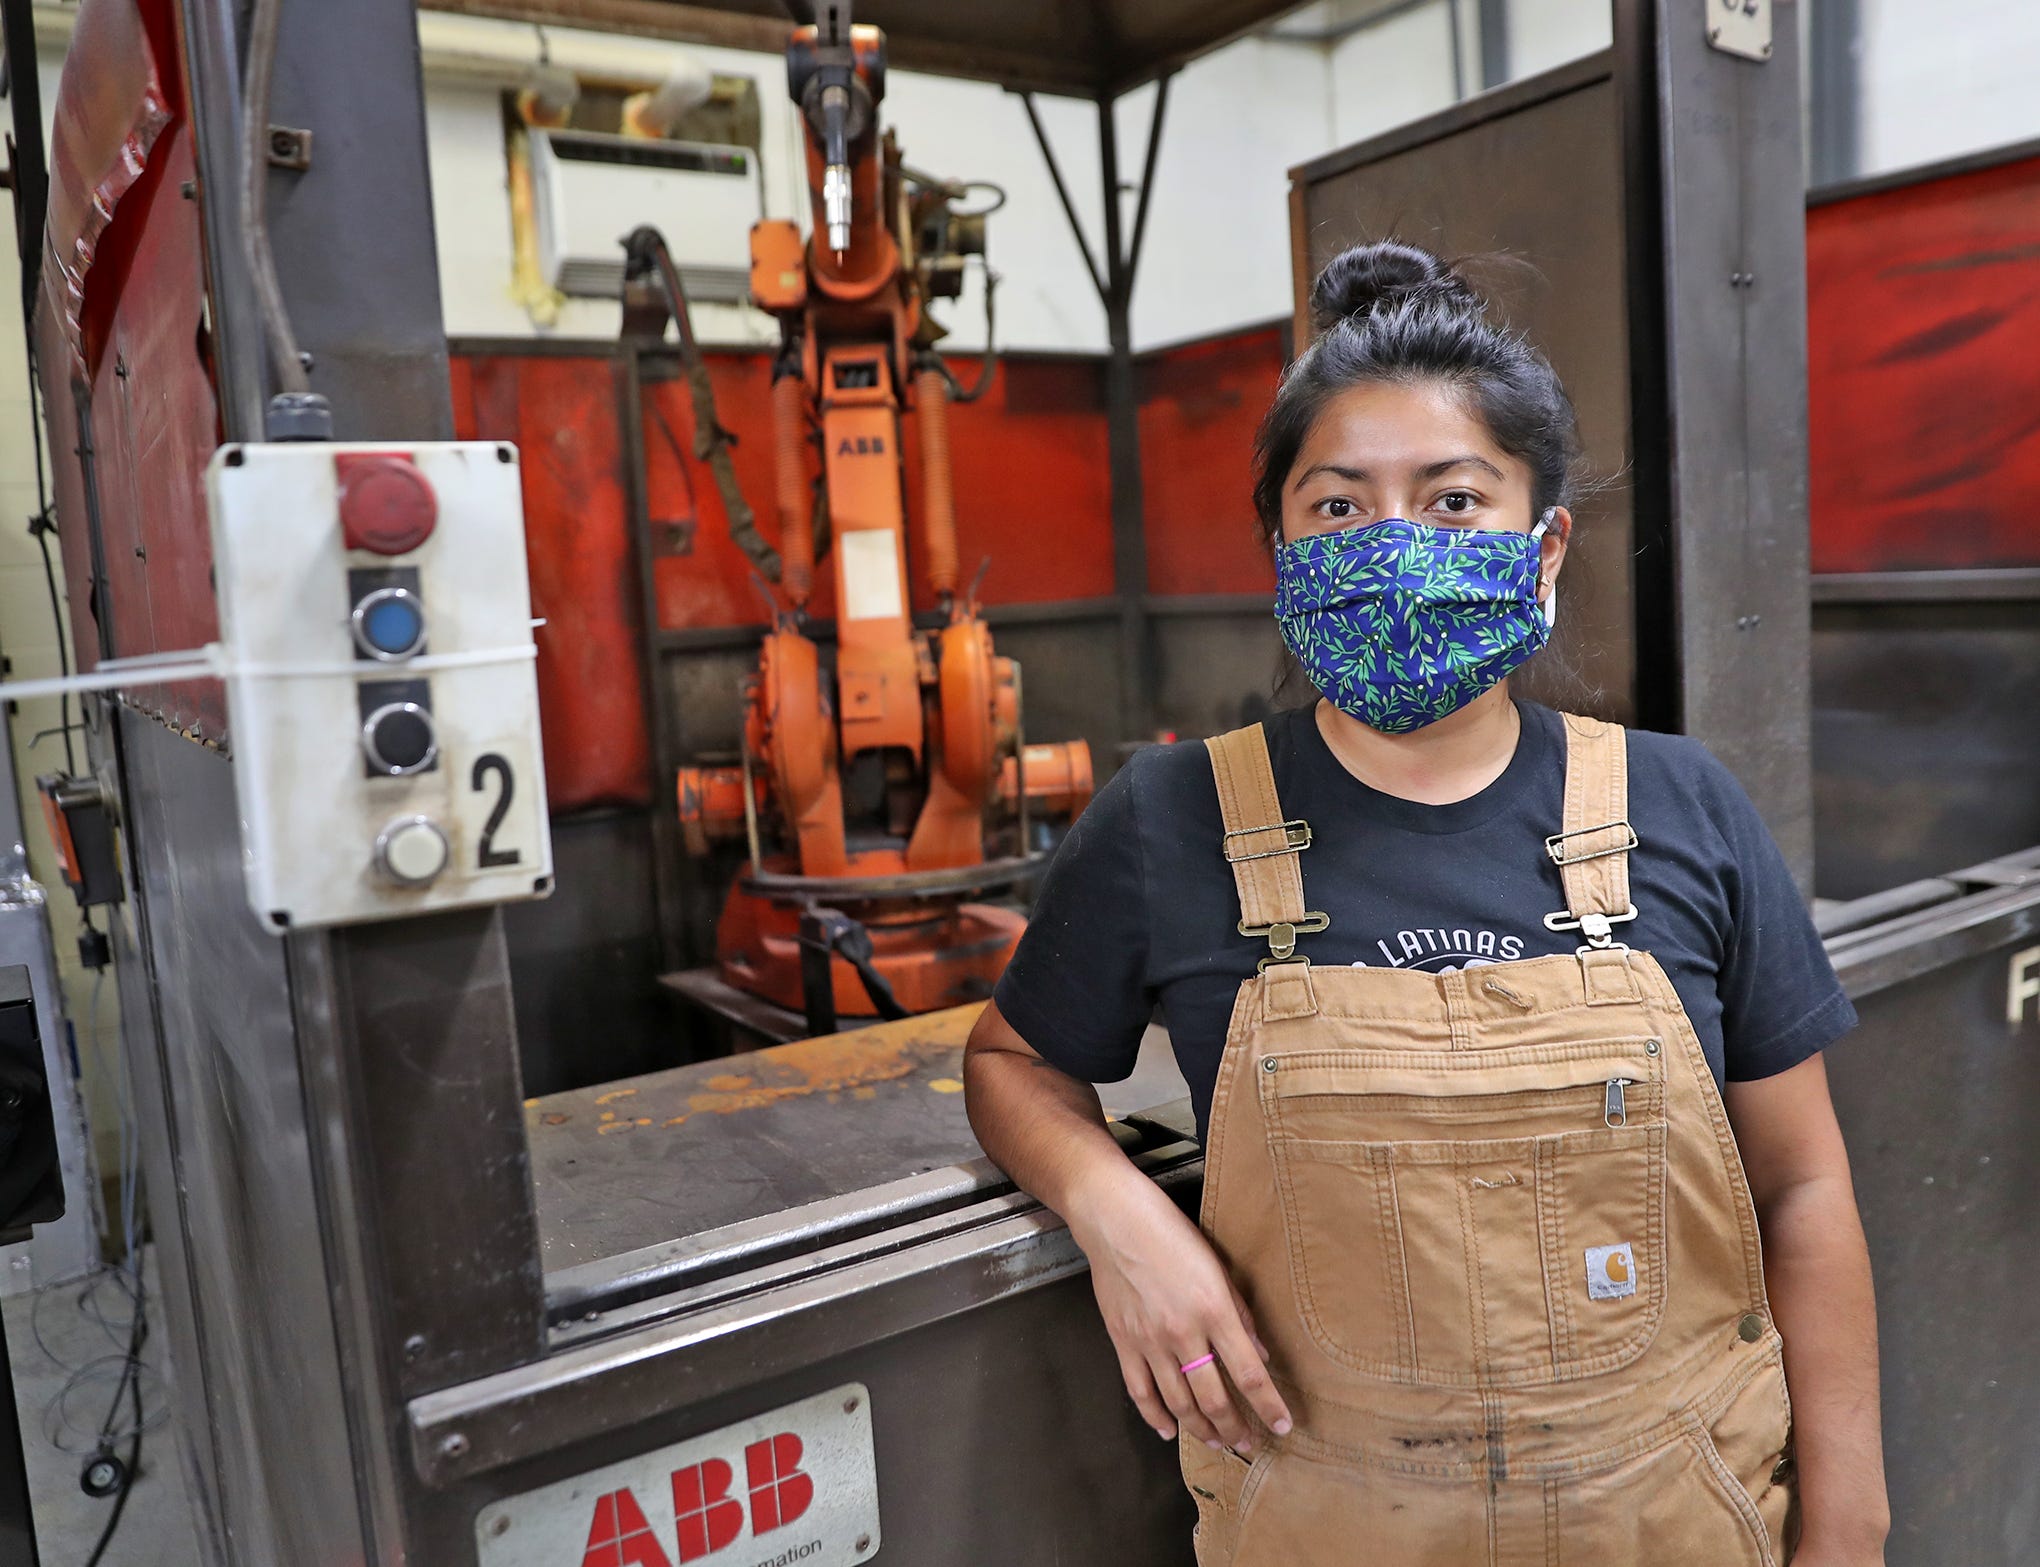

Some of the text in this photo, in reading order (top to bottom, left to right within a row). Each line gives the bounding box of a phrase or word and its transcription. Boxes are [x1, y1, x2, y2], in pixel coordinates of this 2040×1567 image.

[838, 437, 884, 456] ABB
[471, 753, 520, 868] 2
[1377, 928, 1525, 967] LATINAS
[581, 1432, 814, 1567] ABB
[749, 1539, 822, 1567] mation
